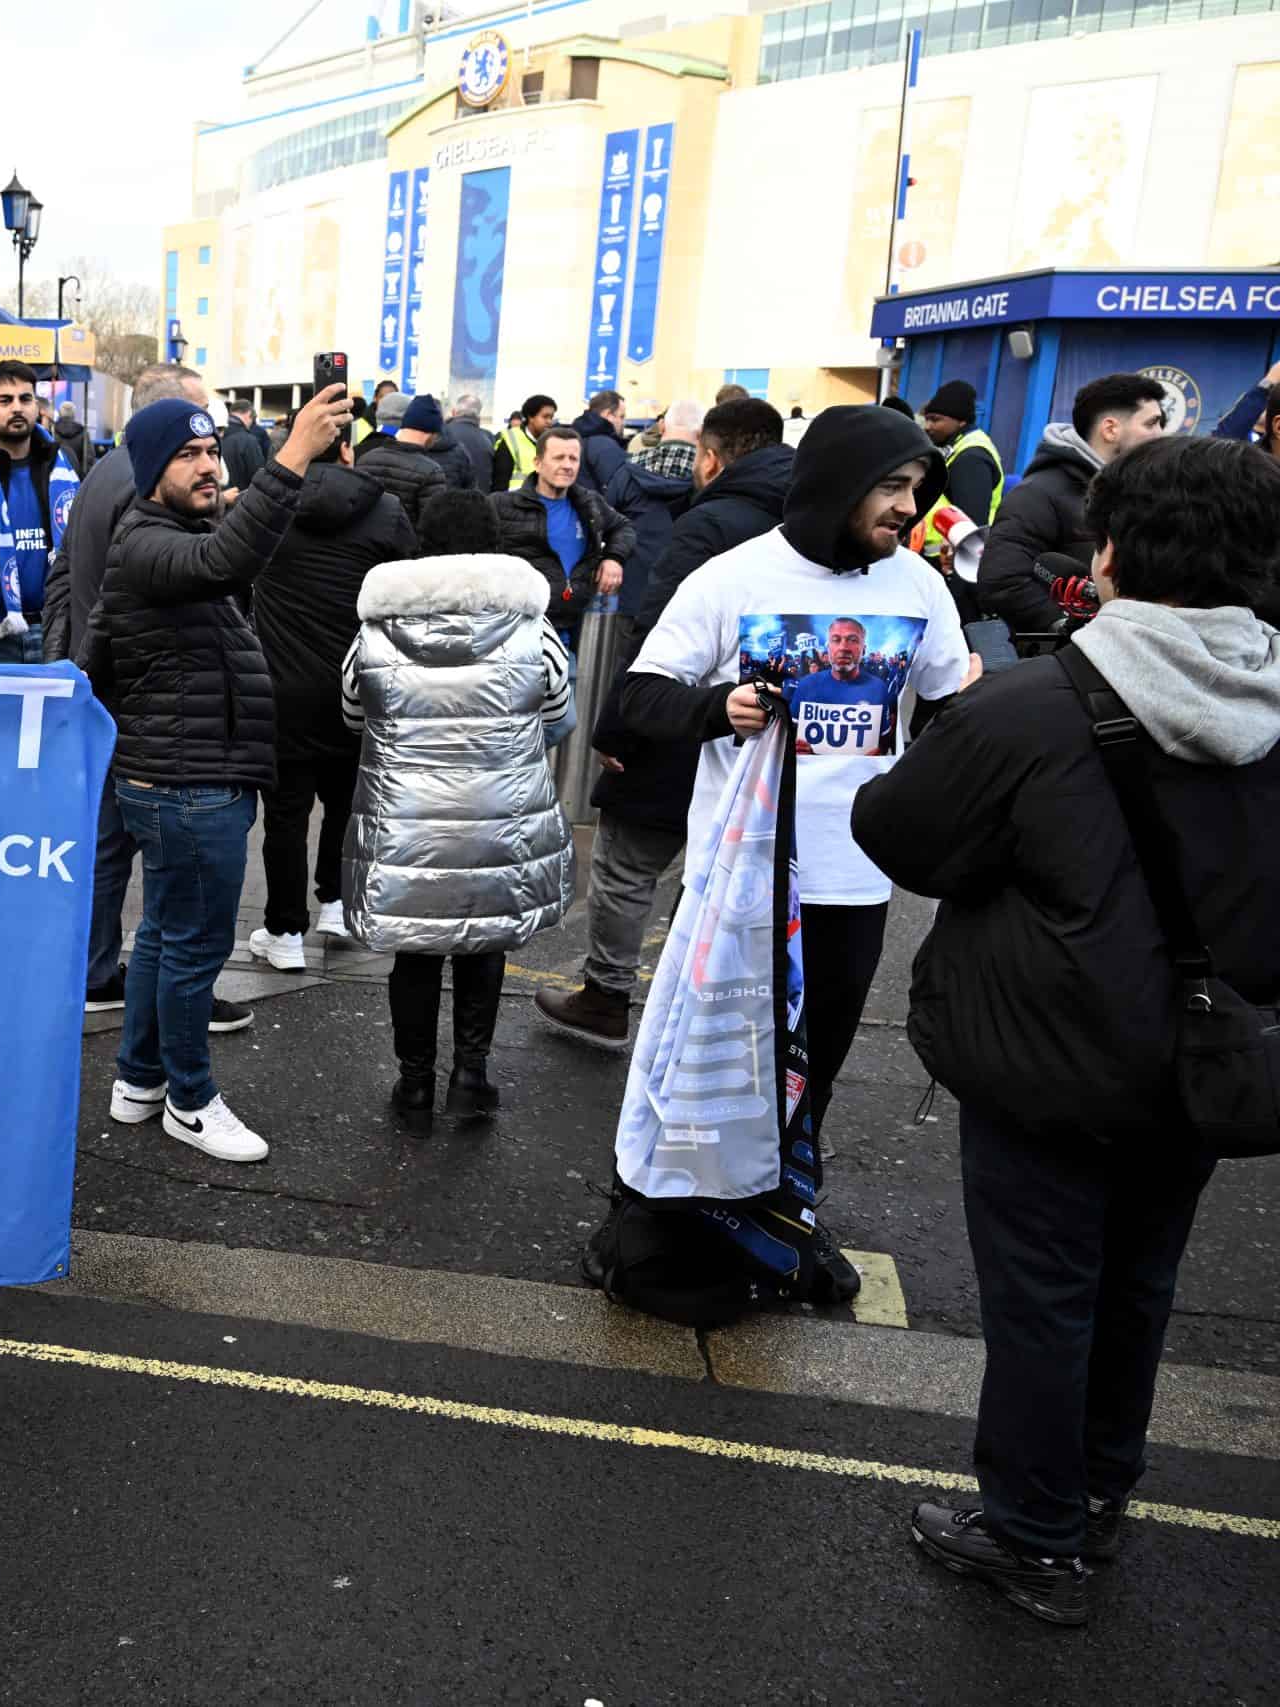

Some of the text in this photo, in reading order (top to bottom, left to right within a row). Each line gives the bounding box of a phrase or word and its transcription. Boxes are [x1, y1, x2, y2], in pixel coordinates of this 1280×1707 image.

[904, 292, 1009, 329] BRITANNIA GATE
[1096, 285, 1237, 311] CHELSEA
[15, 539, 47, 551] ATHL
[803, 702, 872, 723] BlueCo
[804, 722, 873, 748] OUT
